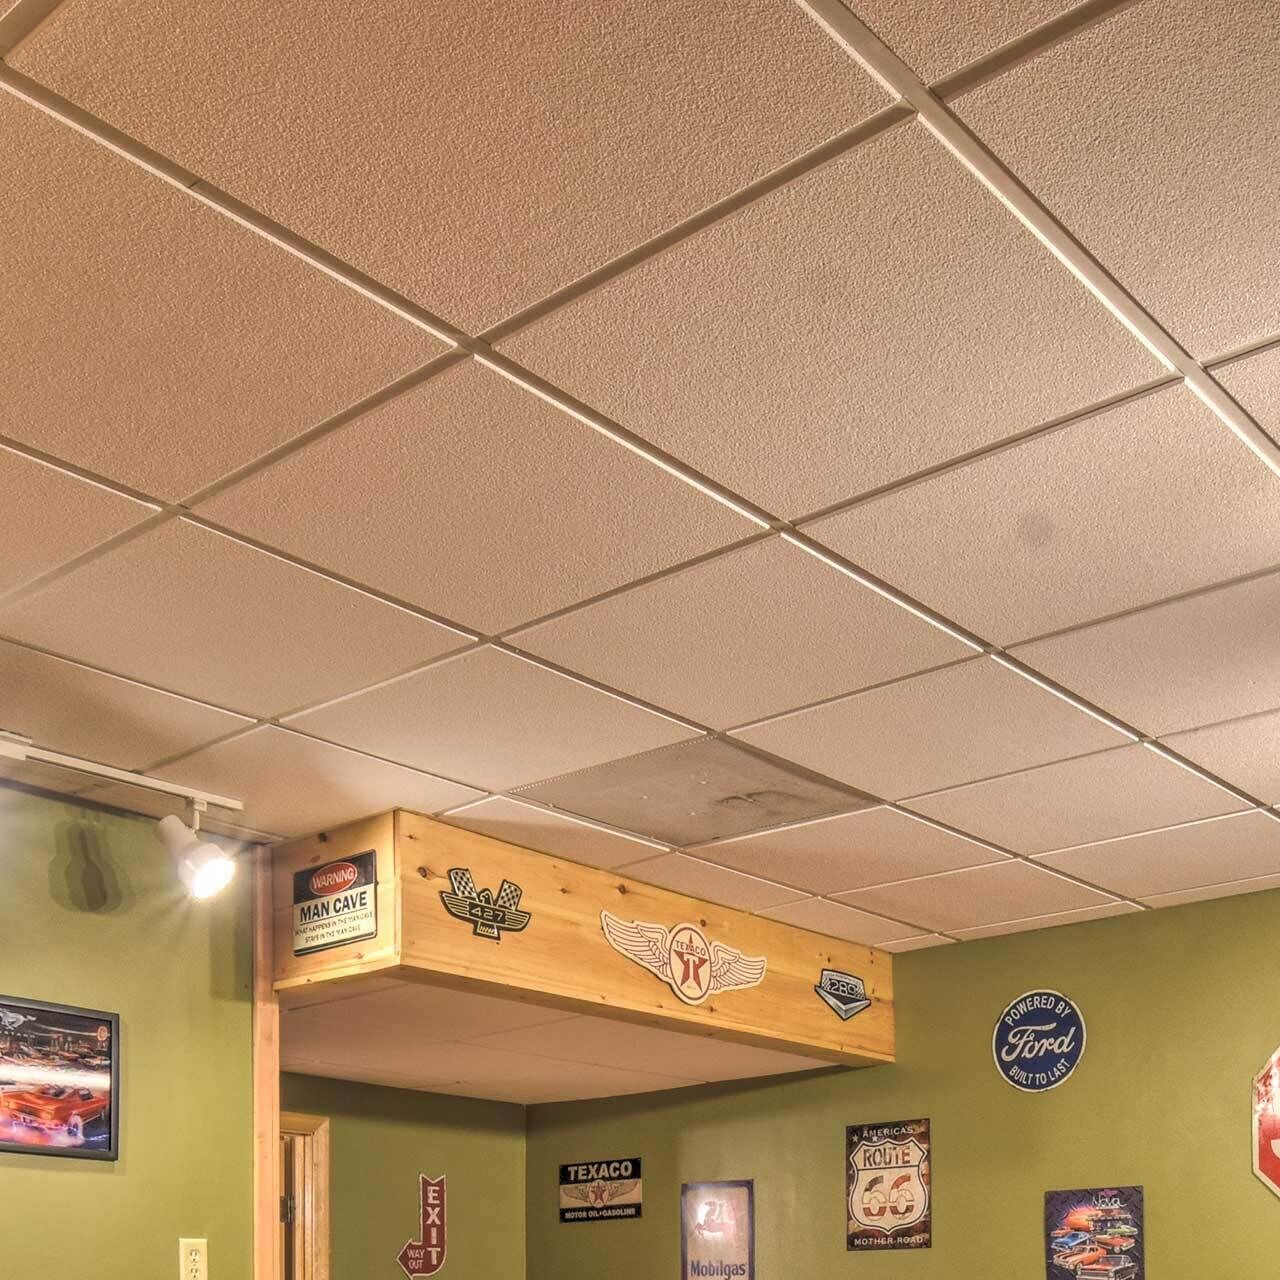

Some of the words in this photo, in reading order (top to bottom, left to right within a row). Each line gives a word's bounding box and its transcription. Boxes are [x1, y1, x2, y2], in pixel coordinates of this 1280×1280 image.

[312, 867, 354, 889] WARNING
[300, 901, 330, 922] MAN
[333, 891, 367, 914] CAVE
[471, 908, 503, 921] 427
[675, 940, 706, 956] TEXACO
[1005, 996, 1055, 1026] POWERED
[1055, 1001, 1072, 1018] BY
[1001, 1022, 1076, 1062] Ford
[1010, 1066, 1033, 1085] BUILT
[1035, 1074, 1047, 1085] TO
[1048, 1058, 1071, 1080] LAST
[864, 1146, 910, 1168] ROUTE
[568, 1161, 632, 1180] TEXACO
[862, 1174, 914, 1220] 66
[1093, 1194, 1127, 1208] Nova
[426, 1186, 440, 1264] EXIT
[854, 1238, 894, 1246] MOTHER
[897, 1236, 923, 1244] ROAD
[406, 1248, 425, 1258] WAY
[408, 1260, 424, 1270] OUT
[690, 1260, 746, 1280] Mobilgas
